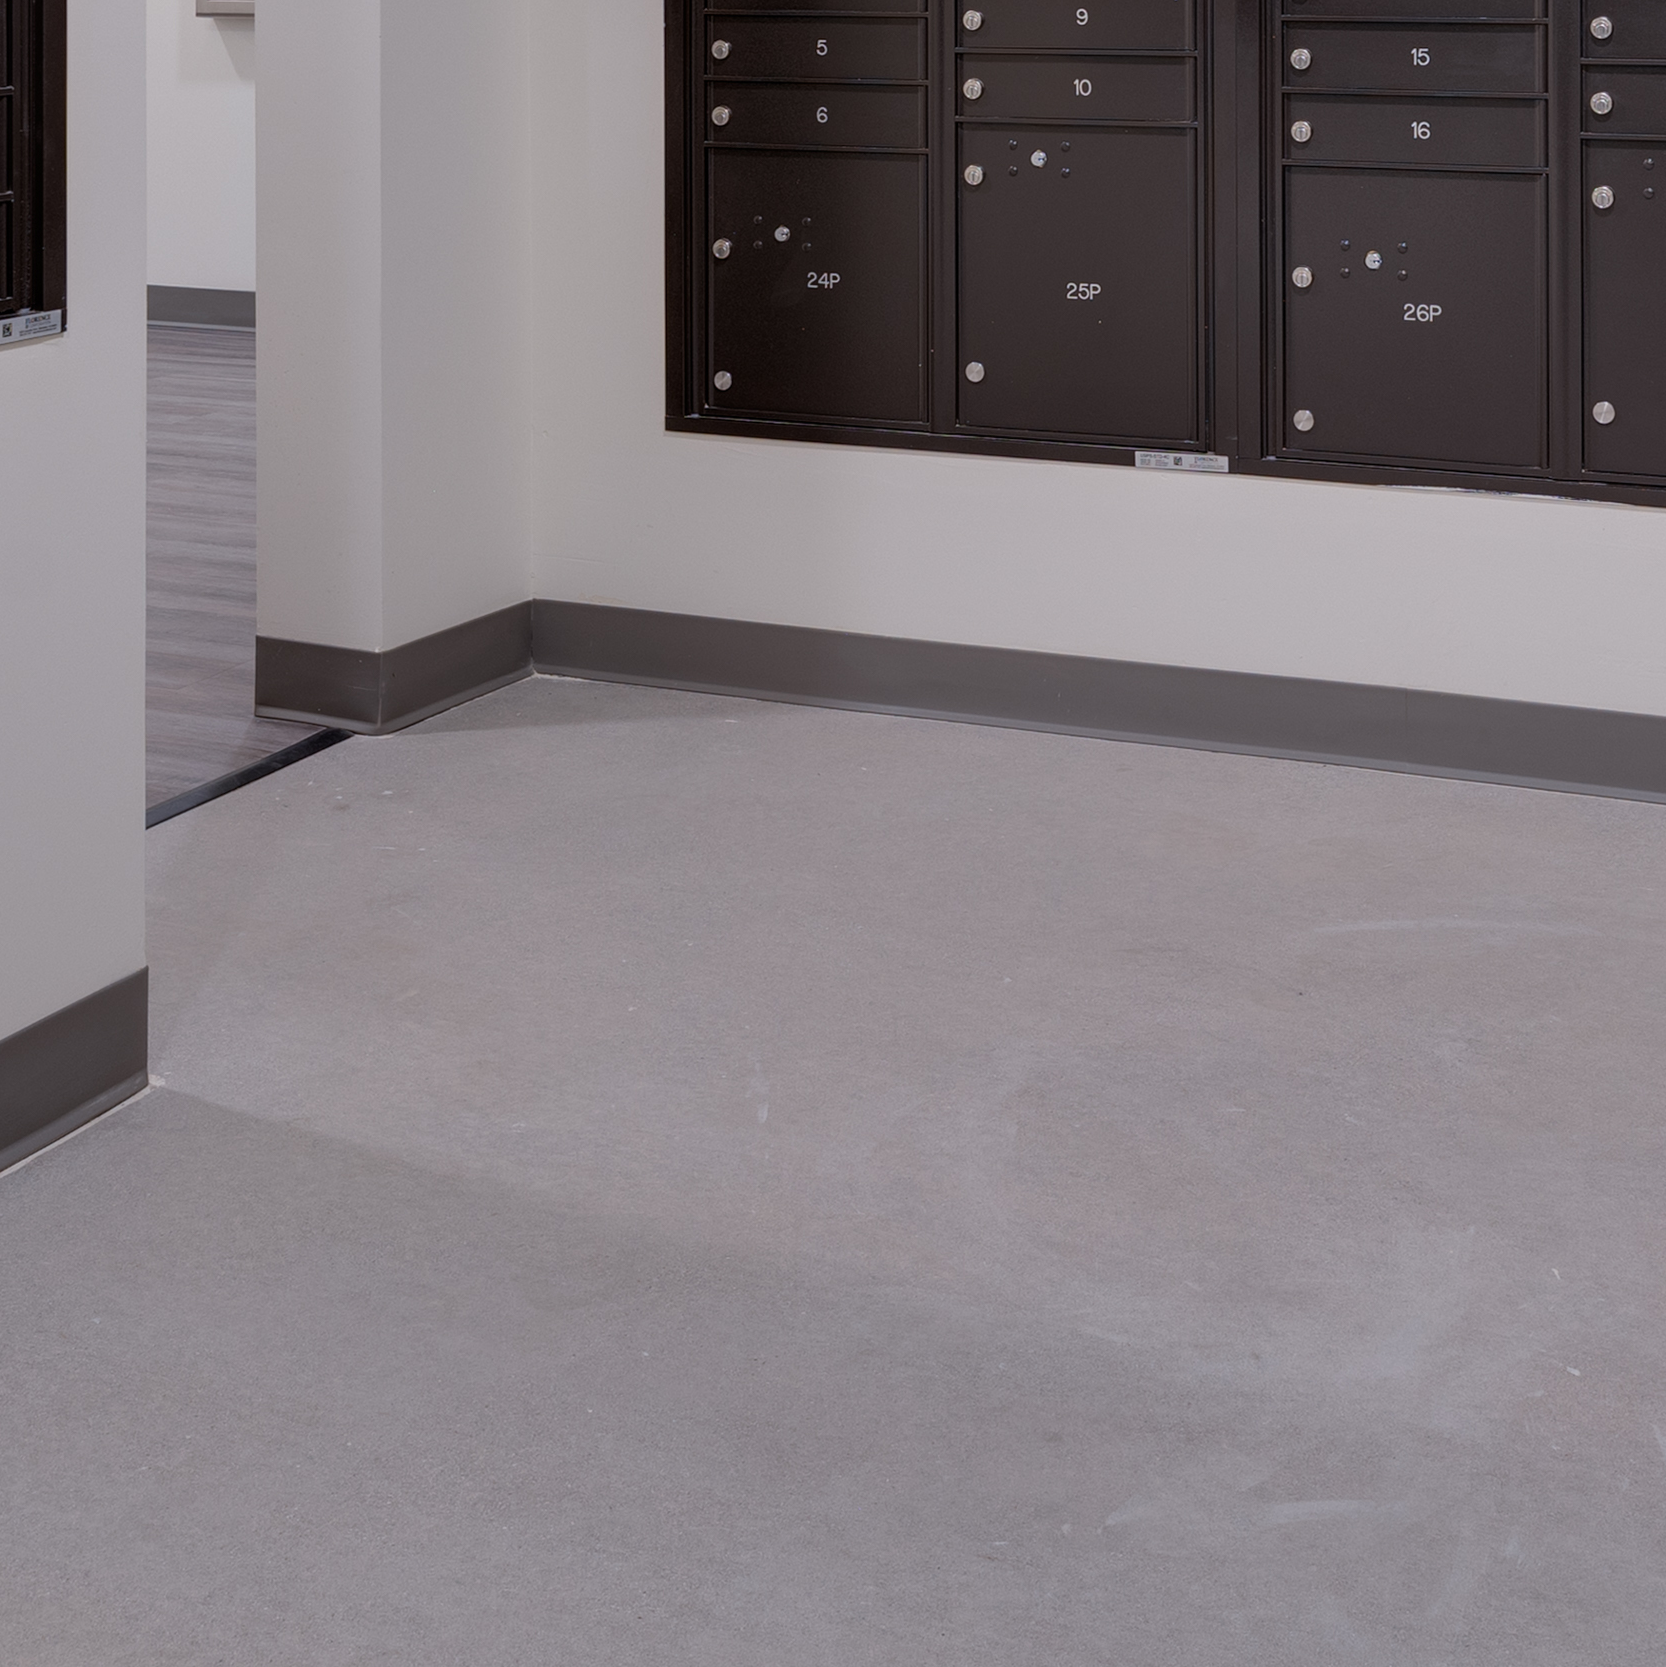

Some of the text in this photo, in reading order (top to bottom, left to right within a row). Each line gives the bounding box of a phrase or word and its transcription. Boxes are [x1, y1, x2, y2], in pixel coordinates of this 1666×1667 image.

[1076, 8, 1089, 26] 9
[816, 39, 828, 56] 5
[1410, 47, 1431, 66] 15
[1073, 78, 1092, 97] 10
[816, 106, 829, 124] 6
[1410, 121, 1431, 140] 16
[807, 271, 841, 289] 24P
[1066, 282, 1102, 300] 25P
[1403, 303, 1442, 322] 26P
